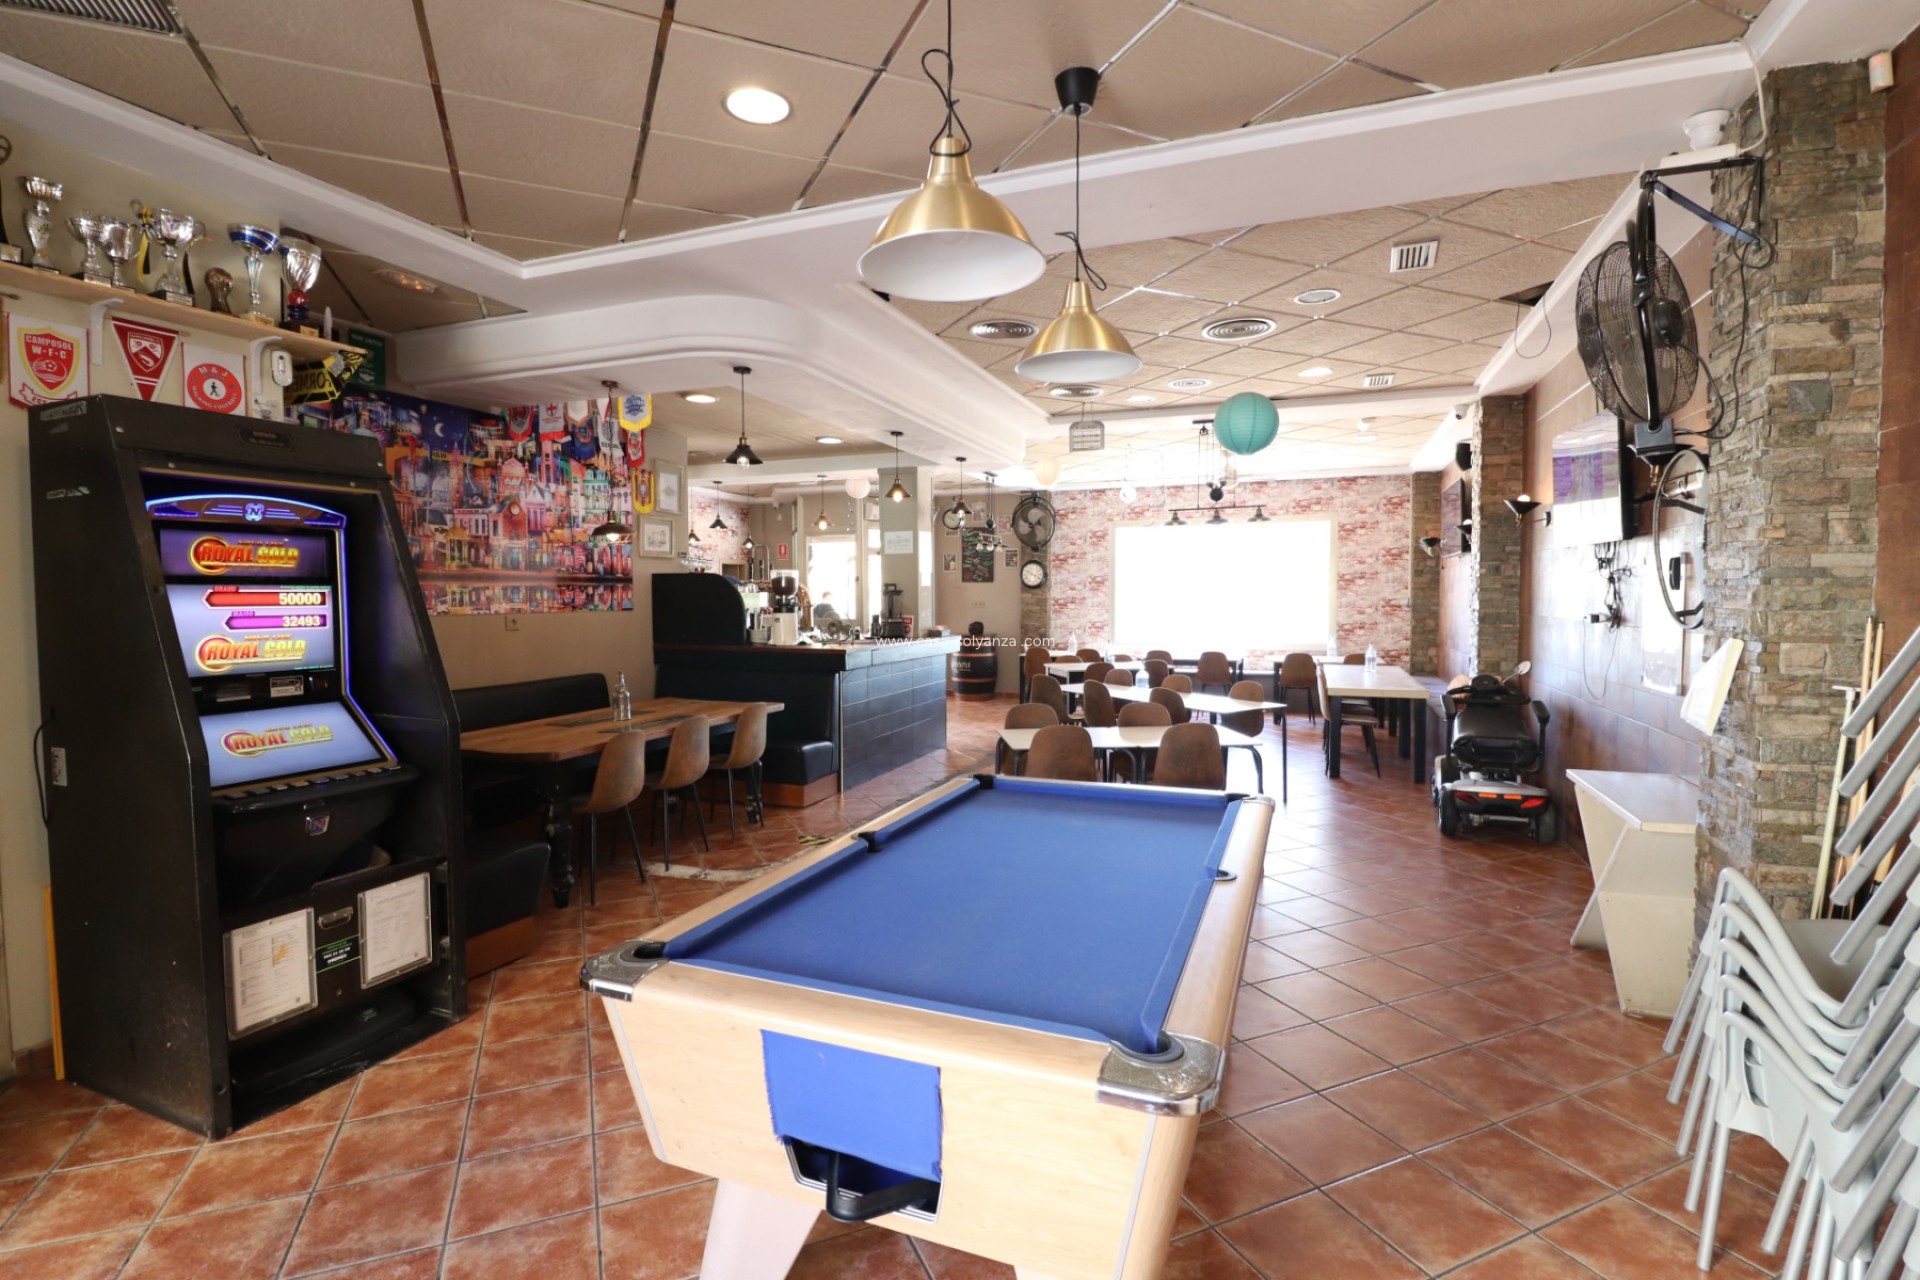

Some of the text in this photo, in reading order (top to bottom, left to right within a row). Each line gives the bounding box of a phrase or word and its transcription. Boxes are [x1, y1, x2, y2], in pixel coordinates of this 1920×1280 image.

[26, 334, 73, 351] CAMPOSOL
[199, 366, 208, 375] M
[200, 544, 299, 564] ROYAL GOLD
[279, 592, 322, 606] 50000
[282, 615, 321, 627] 32493
[206, 640, 306, 661] ROYAL GOLD
[231, 733, 288, 751] ROYAL
[288, 725, 333, 743] GOLD
